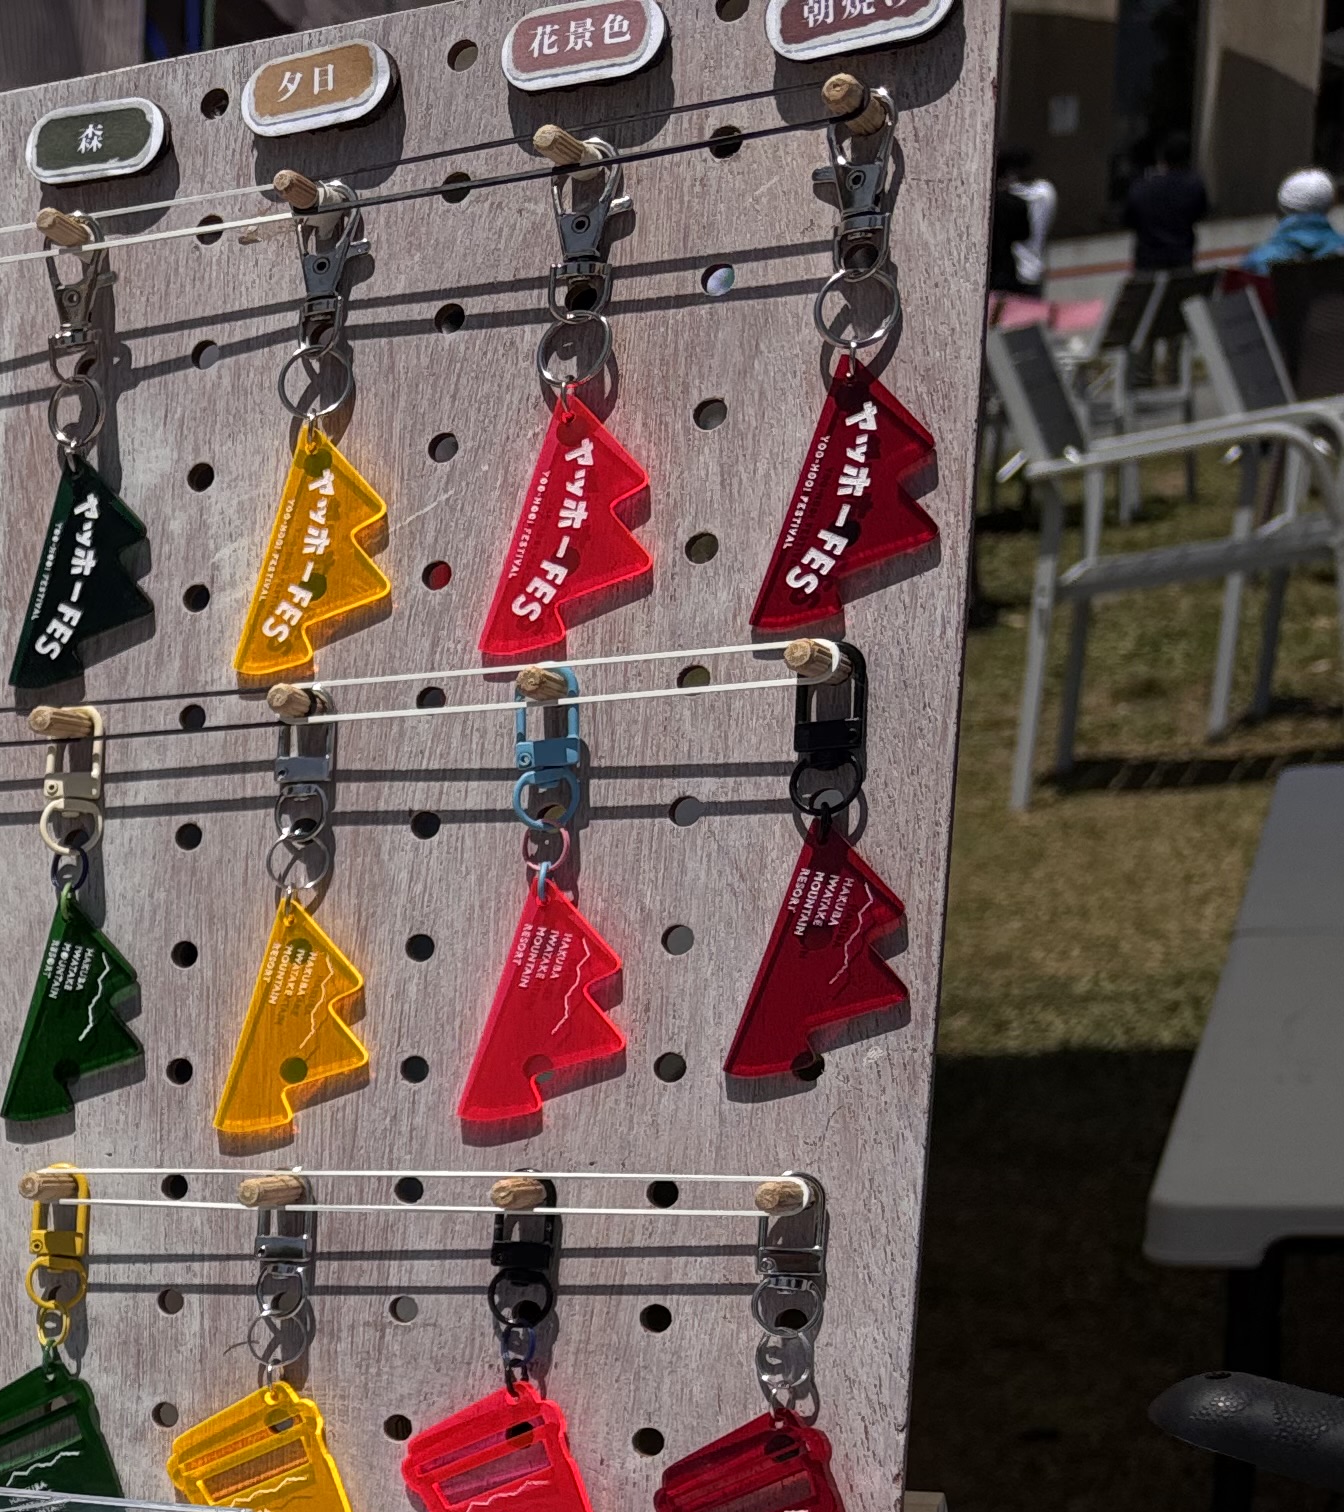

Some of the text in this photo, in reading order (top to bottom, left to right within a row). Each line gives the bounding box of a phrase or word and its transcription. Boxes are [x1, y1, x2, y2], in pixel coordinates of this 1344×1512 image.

[528, 11, 633, 59] 花景色
[276, 63, 335, 103] 夕日
[77, 124, 104, 153] 森
[786, 401, 878, 594] ヤッホーFES
[510, 438, 594, 623] ヤッホーFES
[783, 496, 810, 550] FESTIVAL
[34, 493, 100, 660] ヤッホーFES
[262, 468, 335, 644] ヤッホーFES
[787, 868, 811, 913] RESORT
[794, 871, 826, 936] MOUNTAIN
[813, 874, 840, 927] IWATAKE
[827, 877, 855, 926] HAKUBA
[43, 939, 60, 979] RESORT
[64, 945, 83, 991] IWATAKE
[263, 942, 282, 983] RESORT
[512, 923, 531, 966] RESORT
[518, 926, 548, 989] MOUNTAIN
[535, 929, 560, 980] IWATAKE
[550, 933, 573, 980] HAKUBA
[49, 942, 72, 1000] MOUNTAIN
[75, 948, 94, 991] HAKUBA
[268, 944, 295, 1006] MOUNTAIN
[285, 948, 306, 997] IWATAKE
[298, 951, 318, 997] HAKUBA
